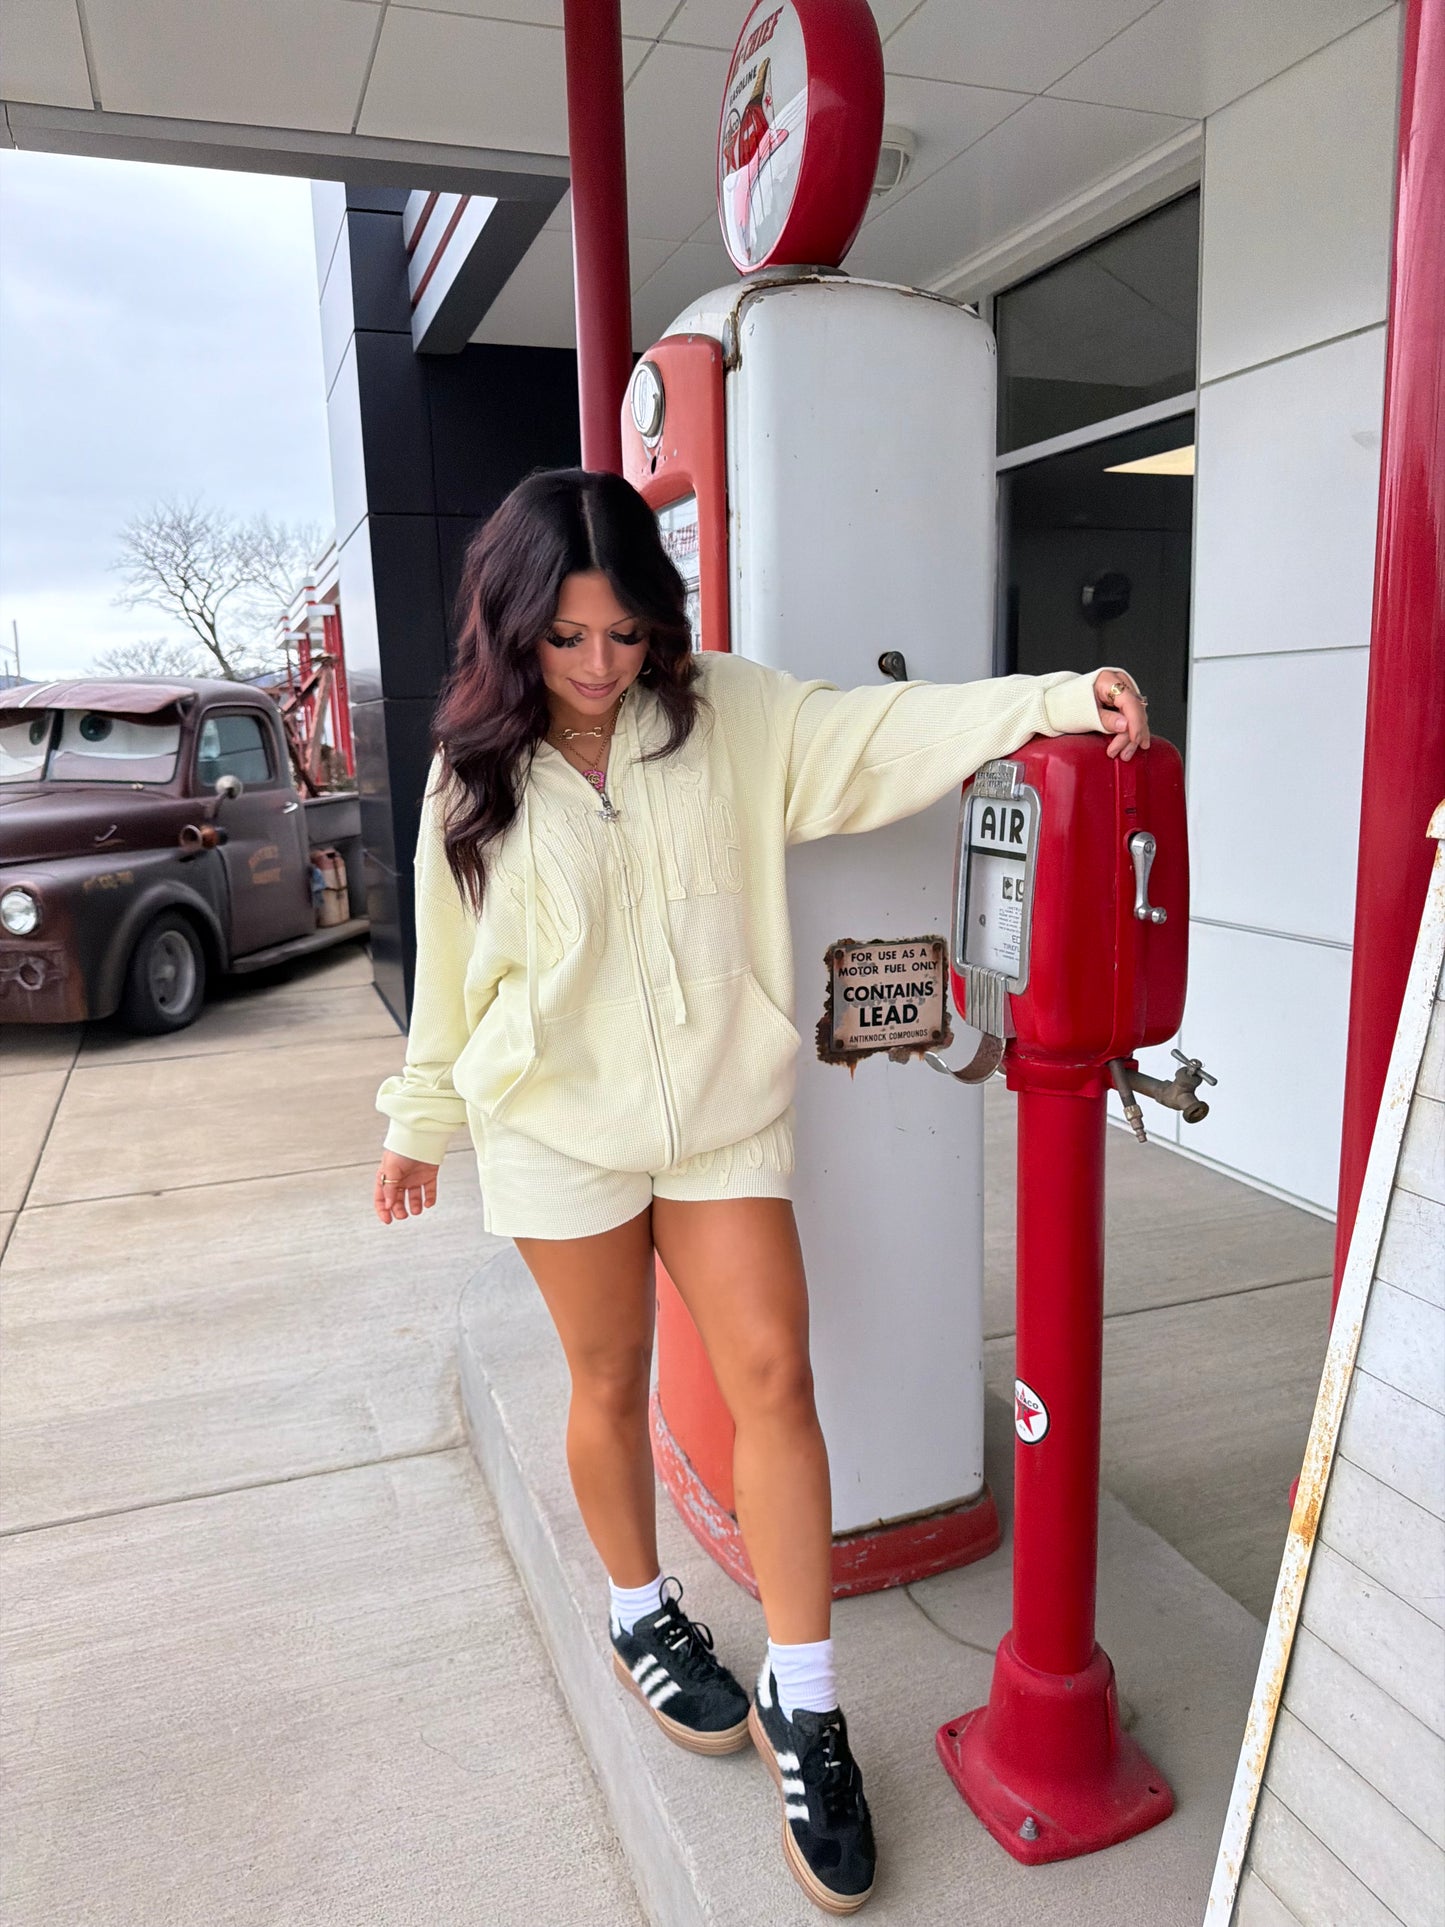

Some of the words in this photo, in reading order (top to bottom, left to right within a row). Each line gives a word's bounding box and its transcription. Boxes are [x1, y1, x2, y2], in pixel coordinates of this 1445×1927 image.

[980, 806, 1025, 844] AIR
[851, 952, 872, 962] FOR
[878, 950, 897, 960] USE
[902, 949, 915, 958] AS
[920, 948, 927, 957] A
[838, 966, 879, 977] MOTOR
[884, 964, 907, 973] FUEL
[912, 961, 938, 971] ONLY
[843, 981, 934, 1002] CONTAINS
[859, 1004, 918, 1028] LEAD
[849, 1033, 887, 1043] ANTIKNOCK
[889, 1029, 928, 1040] COMPOUNDS
[1015, 1390, 1038, 1409] ACO
